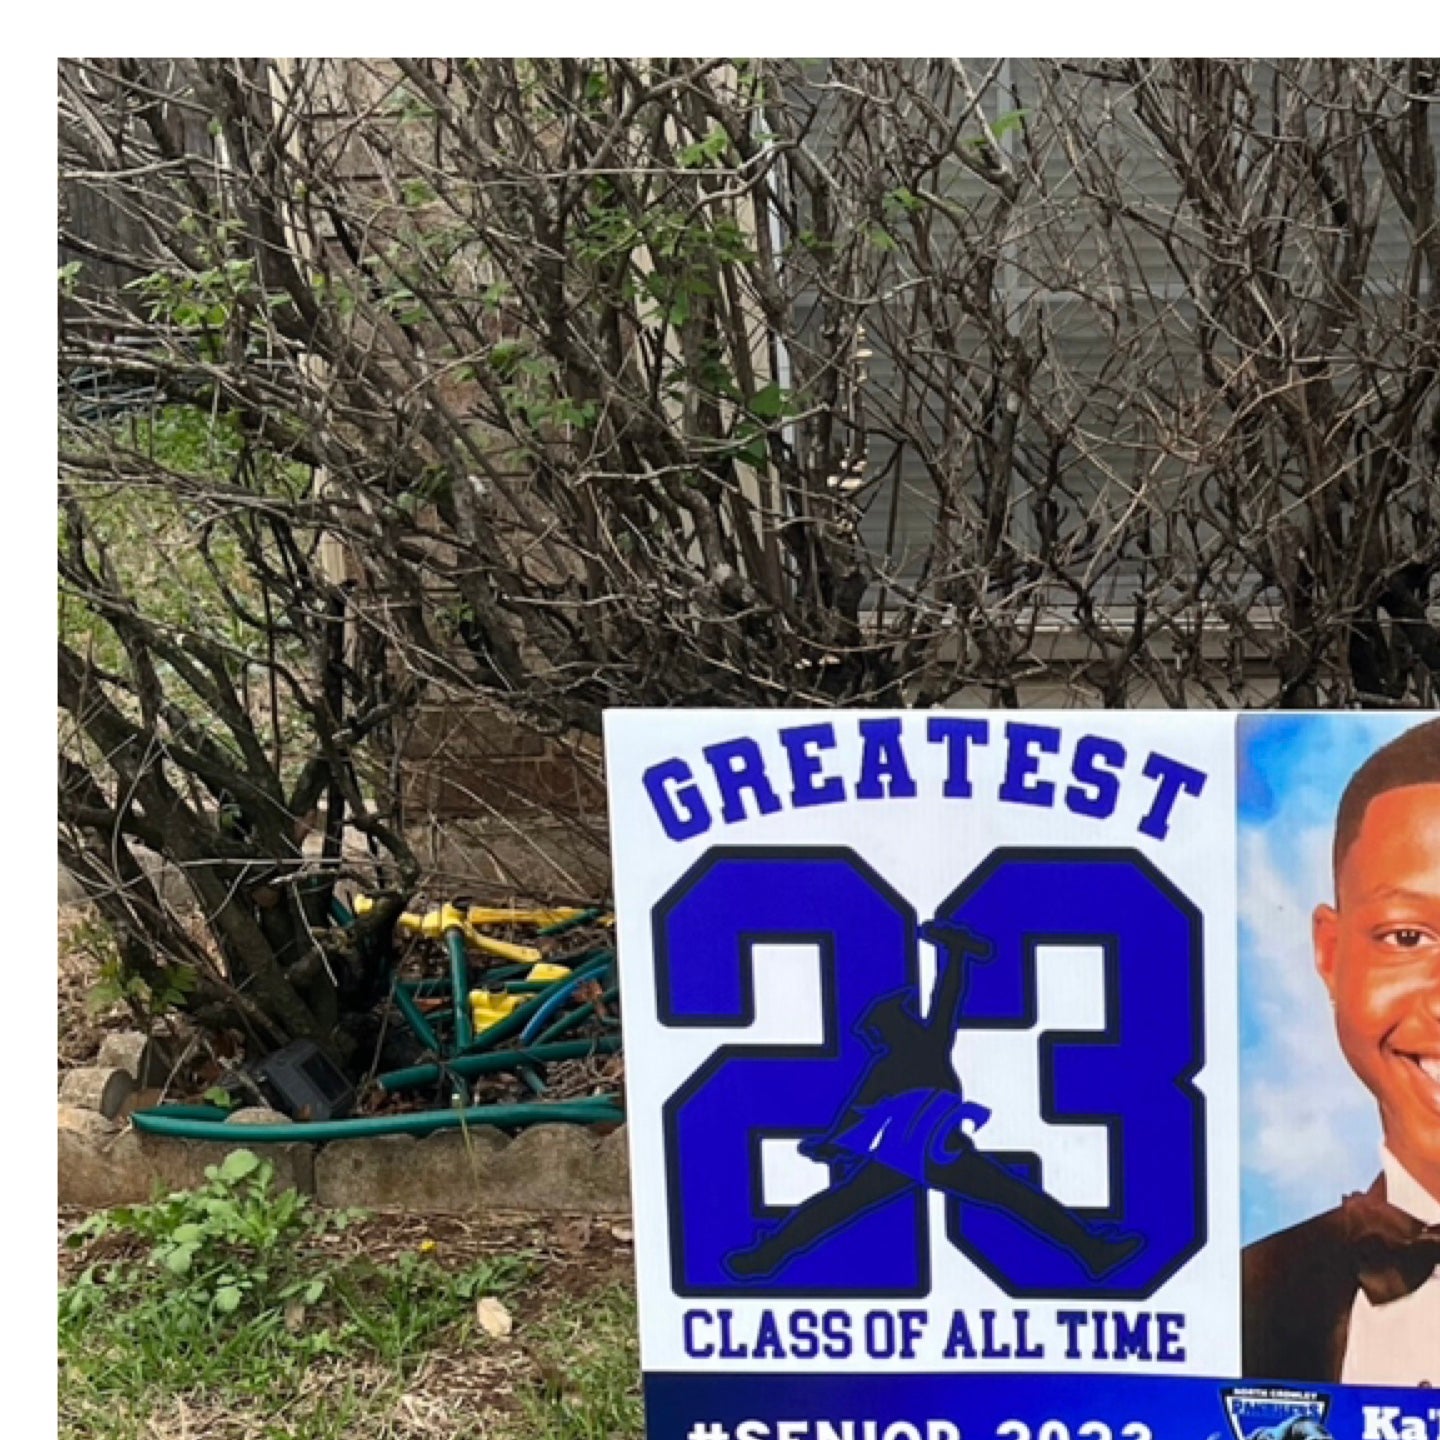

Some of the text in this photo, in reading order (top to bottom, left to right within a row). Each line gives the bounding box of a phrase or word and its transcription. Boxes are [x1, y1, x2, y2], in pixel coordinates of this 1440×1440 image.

[642, 717, 1208, 842] GREATEST
[651, 844, 1208, 1301] 23
[683, 1309, 1187, 1362] CLASS OF ALL TIME
